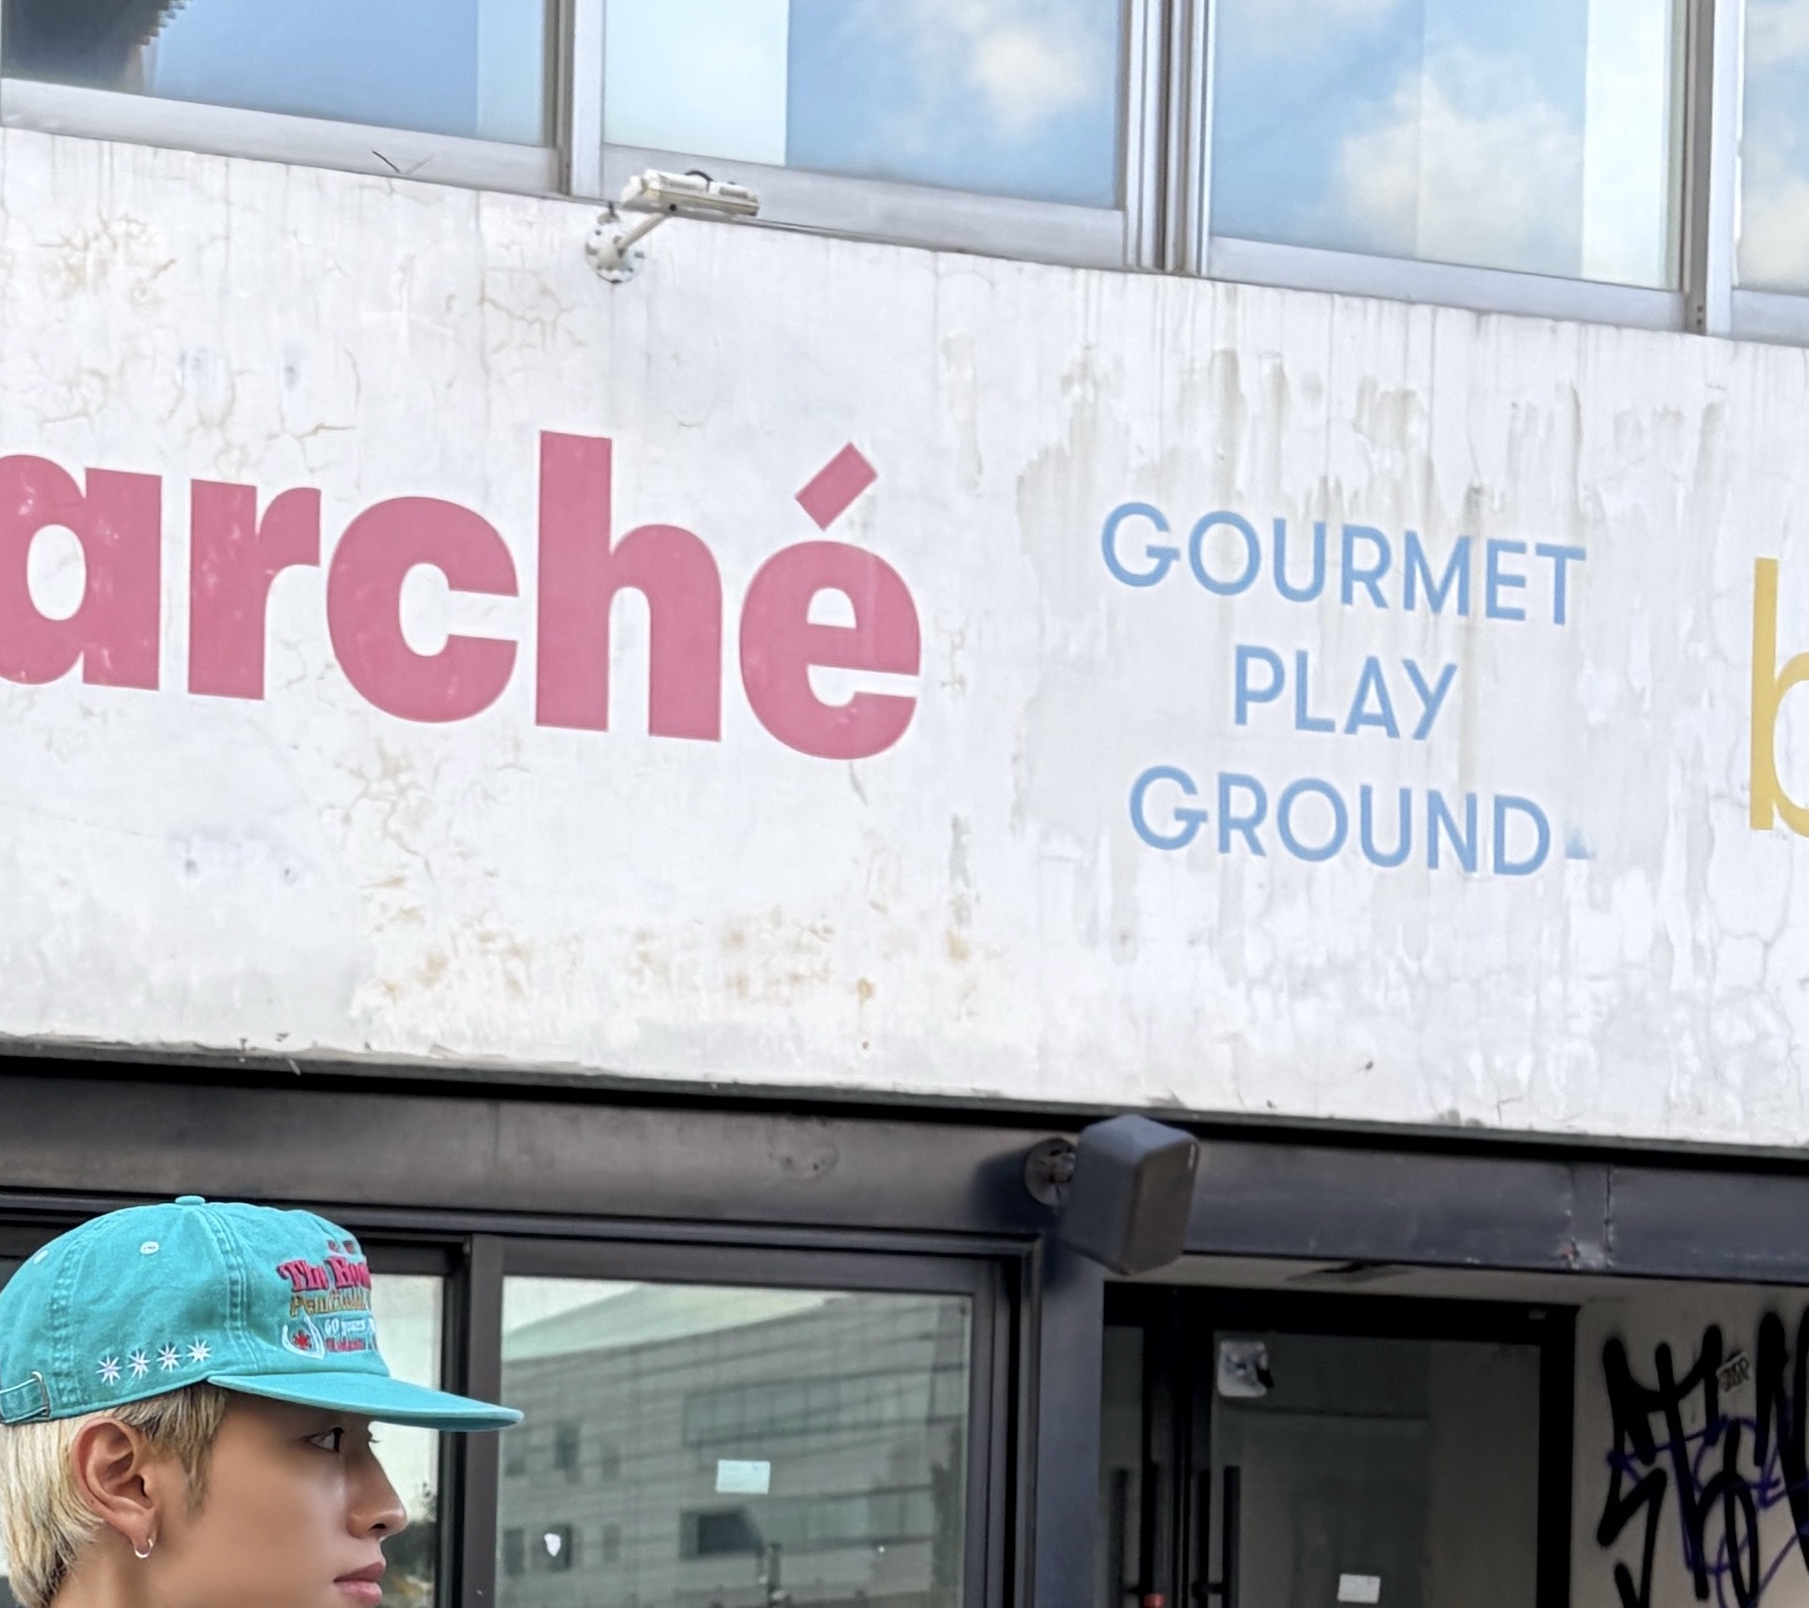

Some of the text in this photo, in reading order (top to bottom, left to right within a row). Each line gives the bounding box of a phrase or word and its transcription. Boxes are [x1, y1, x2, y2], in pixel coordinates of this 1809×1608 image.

[1101, 501, 1587, 626] GOURMET
[1232, 645, 1459, 742] PLAY
[1128, 765, 1552, 877] GROUND
